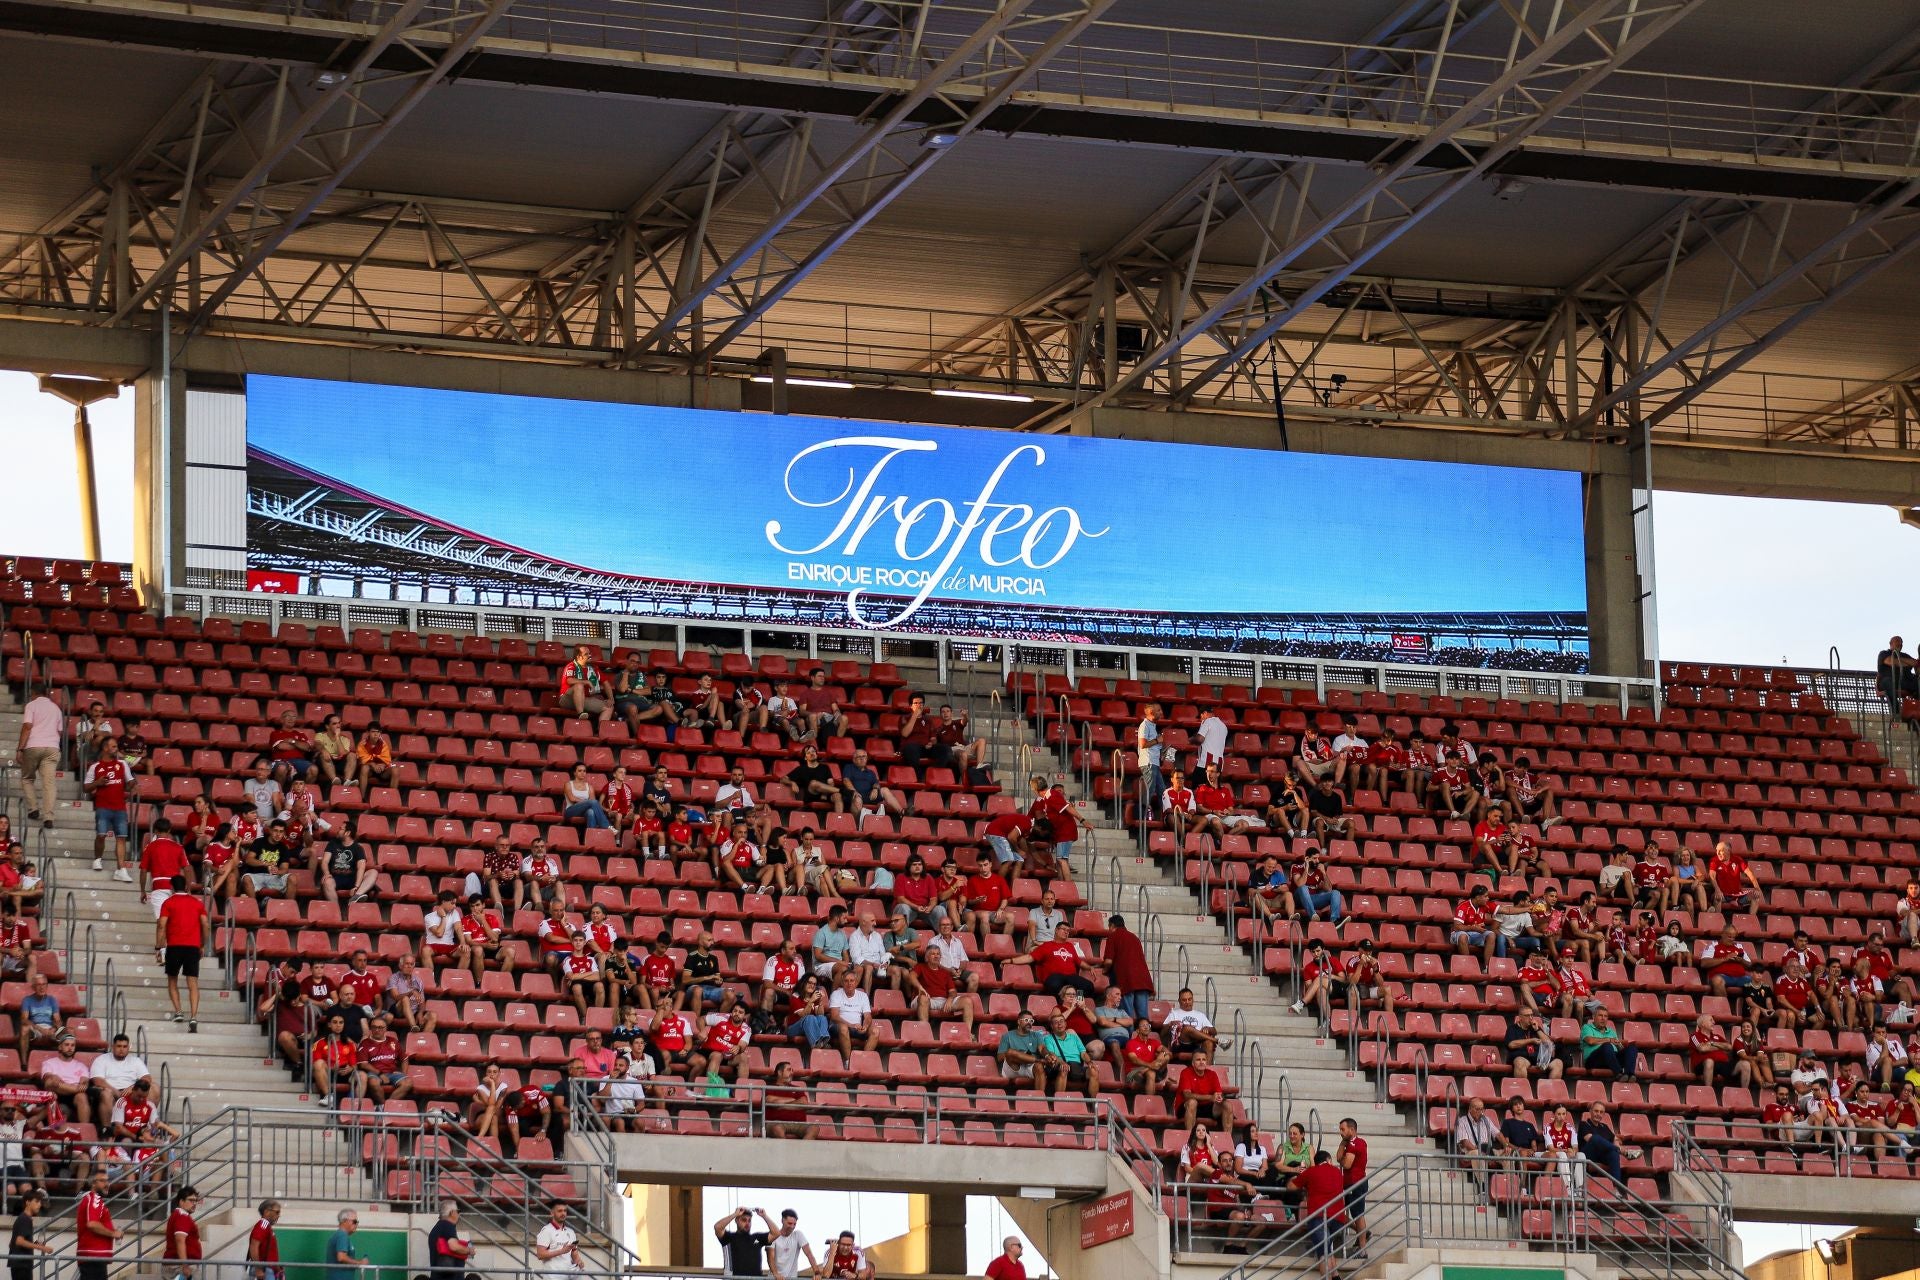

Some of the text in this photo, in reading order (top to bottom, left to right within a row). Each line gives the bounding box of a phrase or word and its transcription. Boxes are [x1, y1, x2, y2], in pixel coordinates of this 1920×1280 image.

[765, 436, 1111, 628] Trofeo
[788, 562, 1047, 596] ENRIQUE ROCA de MURCIA
[1081, 1207, 1096, 1219] Fondo
[1109, 1197, 1128, 1210] Superior
